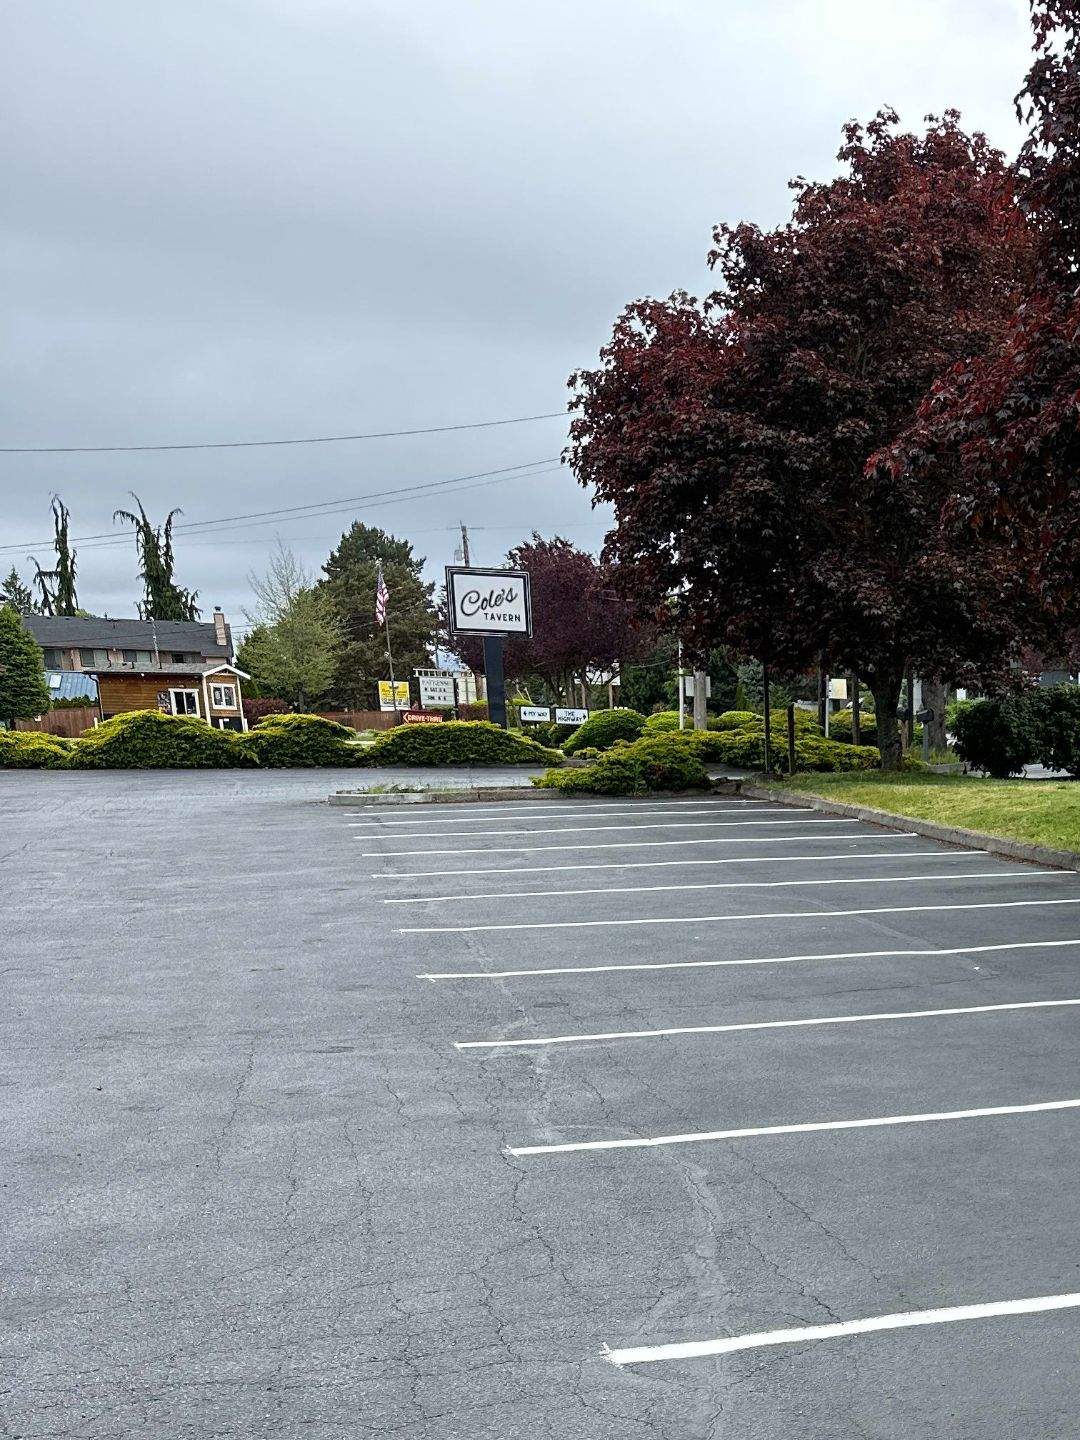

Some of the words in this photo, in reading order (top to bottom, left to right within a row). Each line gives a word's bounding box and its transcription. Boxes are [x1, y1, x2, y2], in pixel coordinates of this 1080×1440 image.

[460, 587, 518, 617] Cole's
[483, 612, 521, 623] TAVERN
[407, 714, 443, 723] DRIVE-THRU
